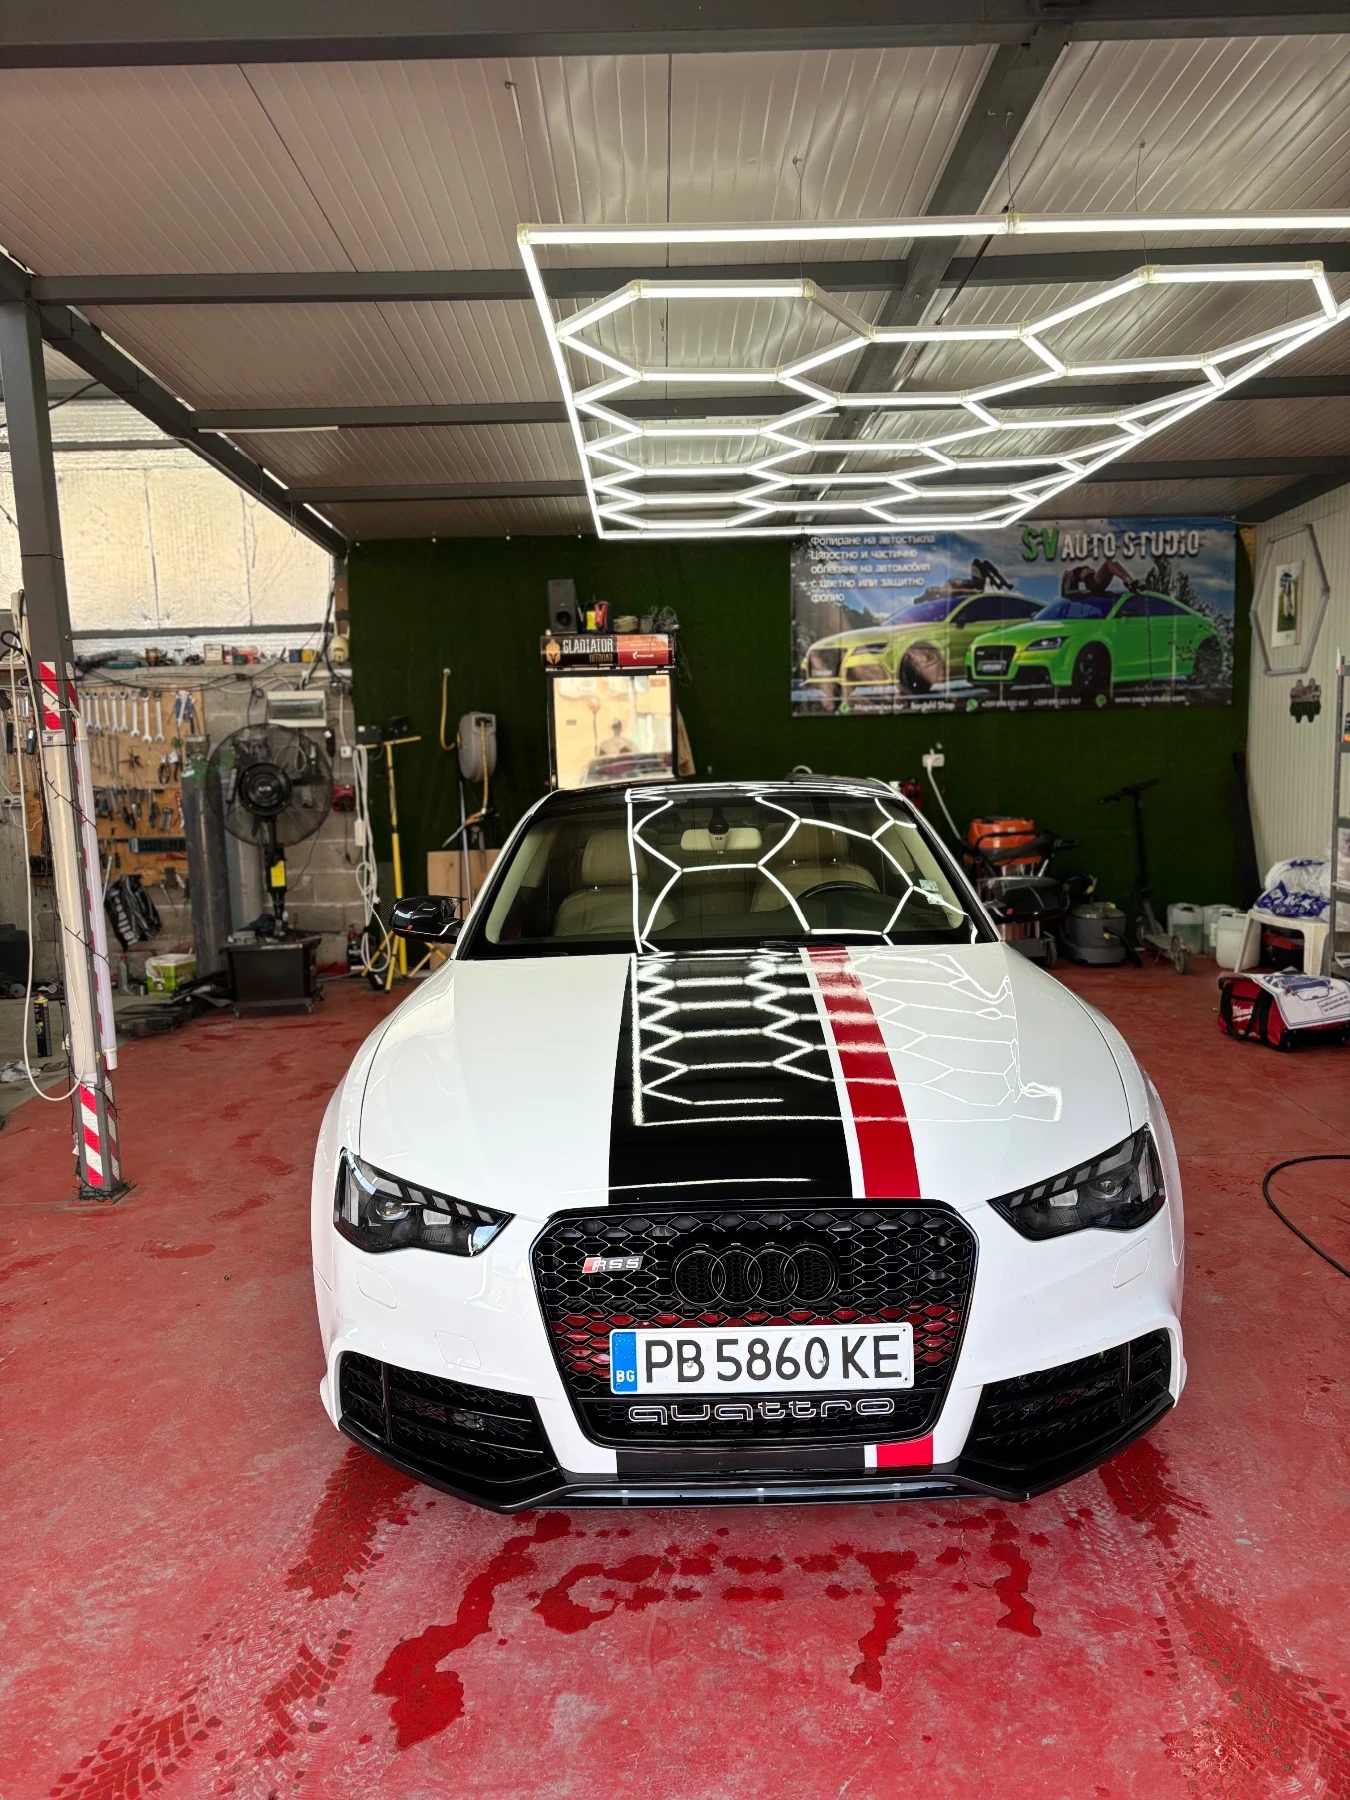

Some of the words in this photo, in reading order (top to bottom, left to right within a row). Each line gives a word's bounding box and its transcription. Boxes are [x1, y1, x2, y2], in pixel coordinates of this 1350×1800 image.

[810, 536, 861, 547] Фолиране
[864, 536, 876, 545] на
[879, 534, 935, 545] автостъкла
[1021, 527, 1059, 561] SV
[1061, 532, 1117, 560] AUTO
[810, 549, 858, 560] Цялостно
[861, 550, 868, 559] и
[871, 549, 918, 559] частично
[861, 565, 873, 573] на
[875, 562, 931, 573] автомобил
[811, 580, 818, 588] с
[820, 579, 855, 589] цветно
[858, 579, 877, 588] или
[881, 577, 925, 588] защитно
[810, 592, 845, 603] фолио
[562, 638, 614, 654] GLADIATOR
[616, 1369, 635, 1383] BG
[645, 1338, 705, 1384] PB
[716, 1336, 830, 1382] 5860
[841, 1333, 902, 1380] KE
[628, 1397, 895, 1425] quattro
